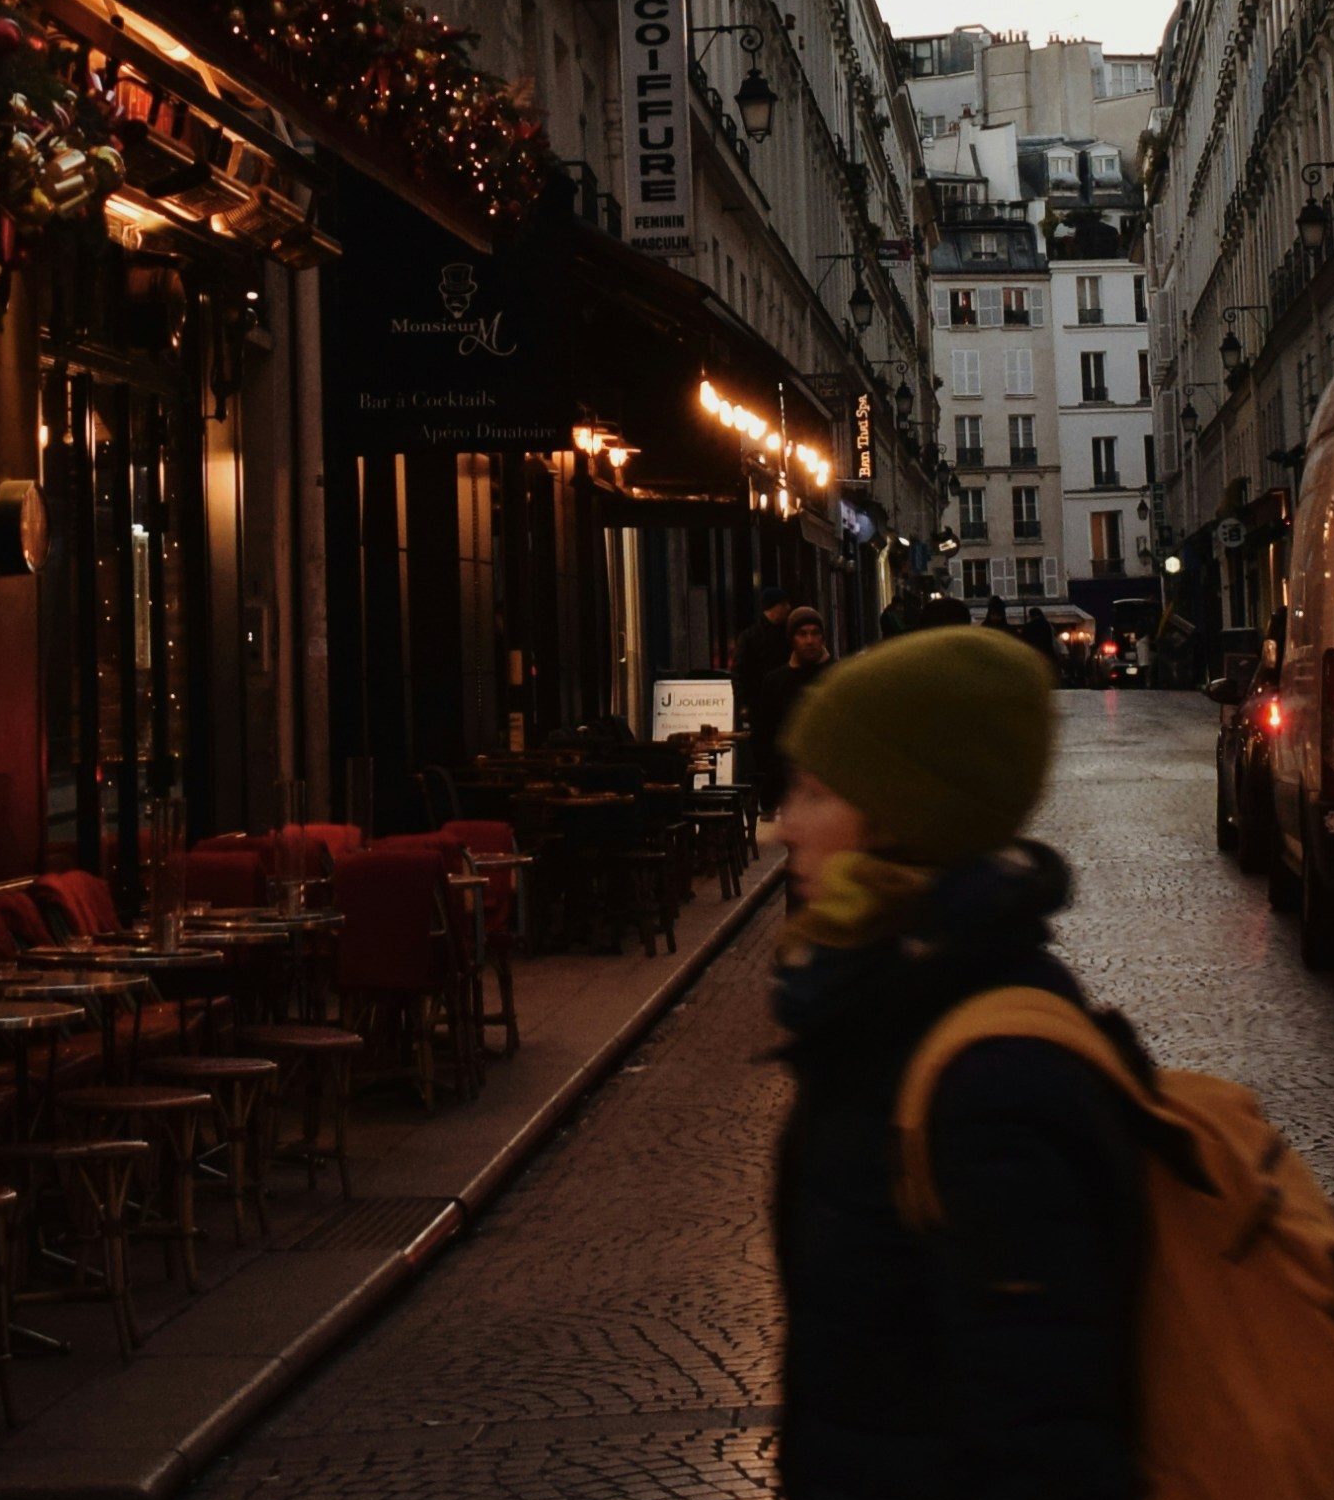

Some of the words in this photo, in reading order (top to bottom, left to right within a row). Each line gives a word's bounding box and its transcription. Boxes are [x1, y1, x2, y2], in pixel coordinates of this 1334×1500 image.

[634, 215, 685, 229] FEMININ
[630, 235, 690, 250] MASCULIN
[390, 317, 478, 334] Monsieur
[358, 391, 391, 410] Bar
[395, 391, 405, 408] à
[411, 390, 498, 408] Cocktails
[855, 393, 871, 419] Spa
[419, 423, 471, 445] Apéro
[676, 698, 726, 707] JOUBERT
